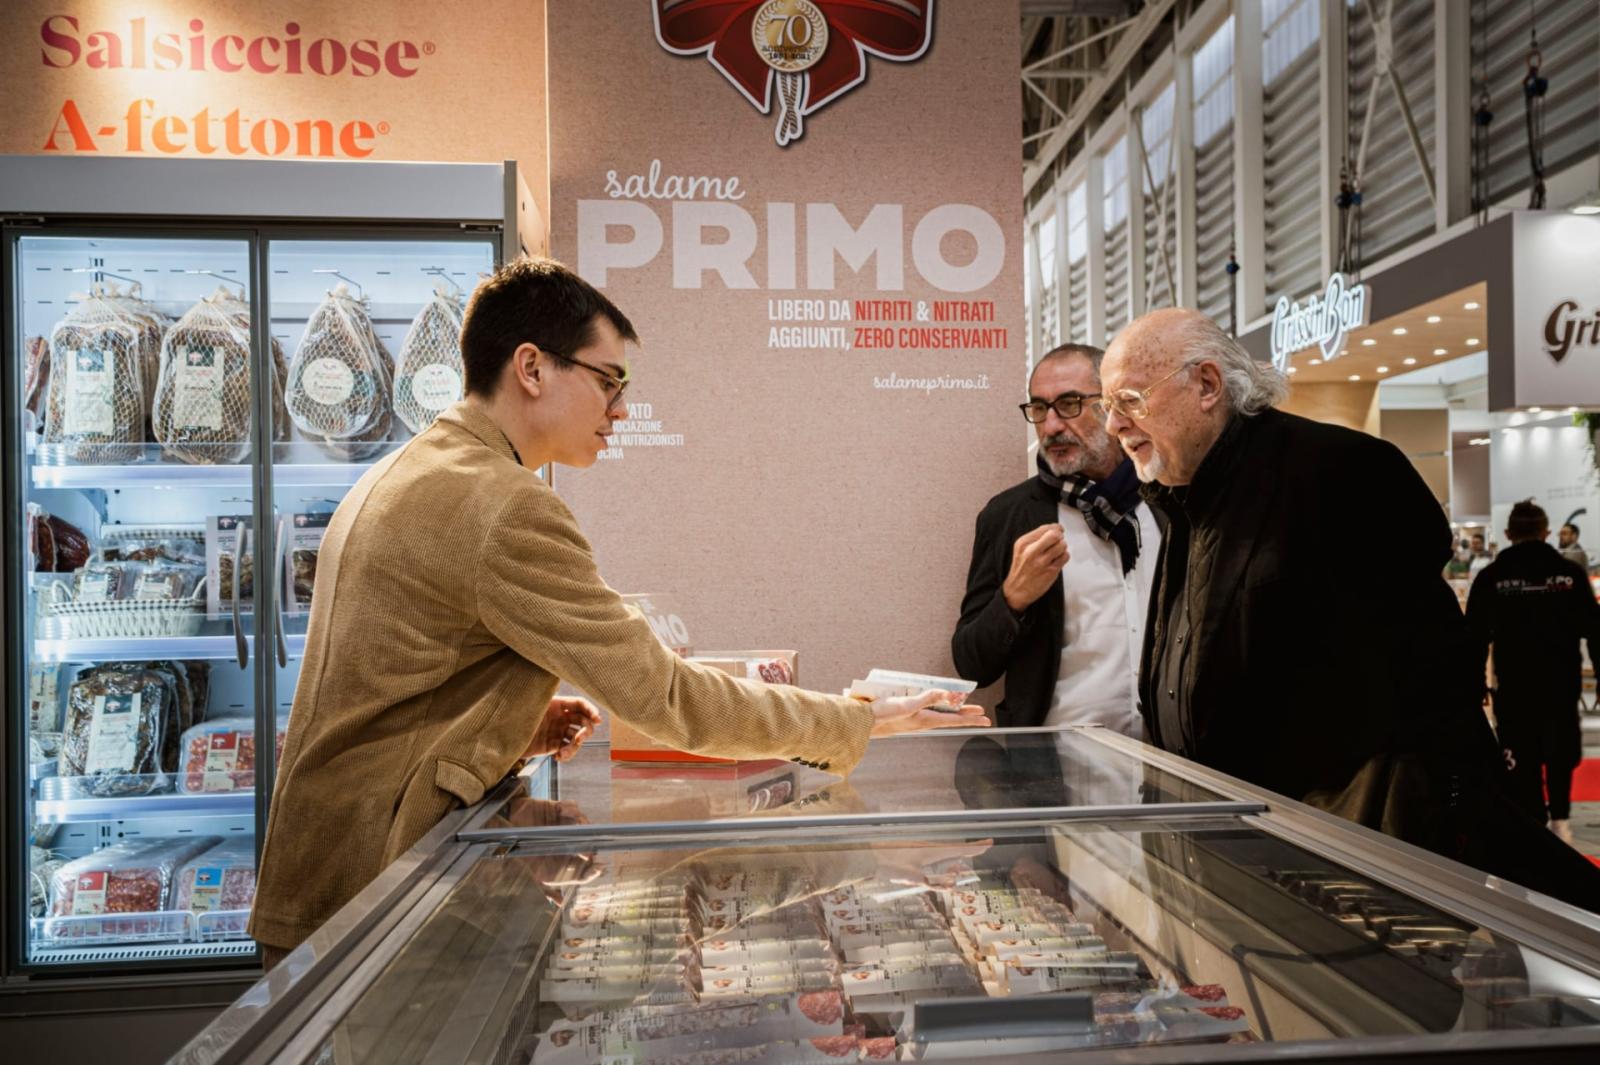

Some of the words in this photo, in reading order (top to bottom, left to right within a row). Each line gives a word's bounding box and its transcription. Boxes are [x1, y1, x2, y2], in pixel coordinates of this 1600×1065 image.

[768, 14, 812, 46] 70
[604, 159, 745, 200] salame
[577, 199, 1006, 292] PRIMO
[768, 299, 825, 321] LIBERO
[829, 299, 851, 321] DA
[855, 300, 912, 321] NITRITI
[916, 300, 930, 321] &
[934, 301, 994, 322] NITRATI
[768, 326, 850, 351] AGGIUNTI,
[854, 327, 895, 349] ZERO
[899, 327, 1008, 350] CONSERVANTI
[873, 372, 990, 396] salameprimo.it
[621, 434, 684, 446] NUTRIZIONISTI
